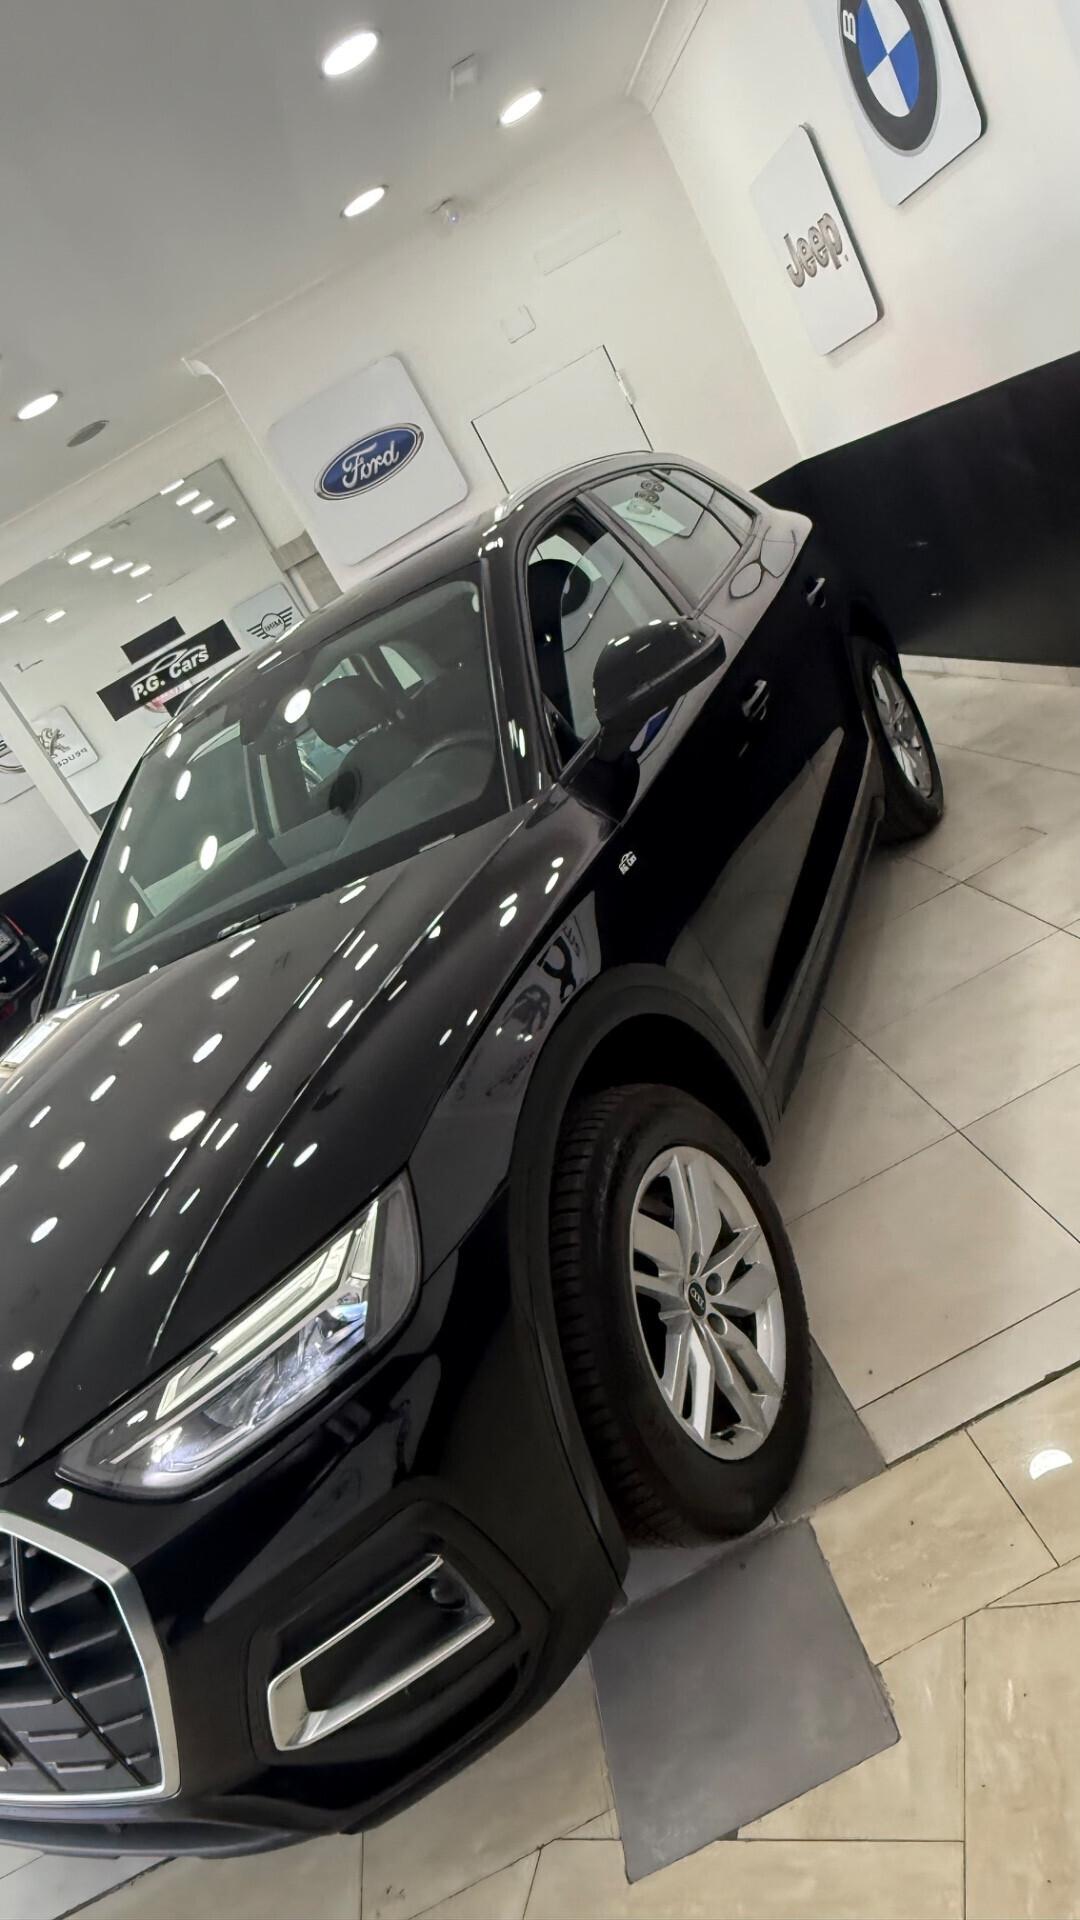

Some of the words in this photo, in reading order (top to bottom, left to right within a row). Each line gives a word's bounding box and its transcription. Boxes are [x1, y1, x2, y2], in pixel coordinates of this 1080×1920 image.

[342, 440, 400, 489] Ford
[132, 675, 166, 701] P.G.
[169, 649, 210, 679] Cars
